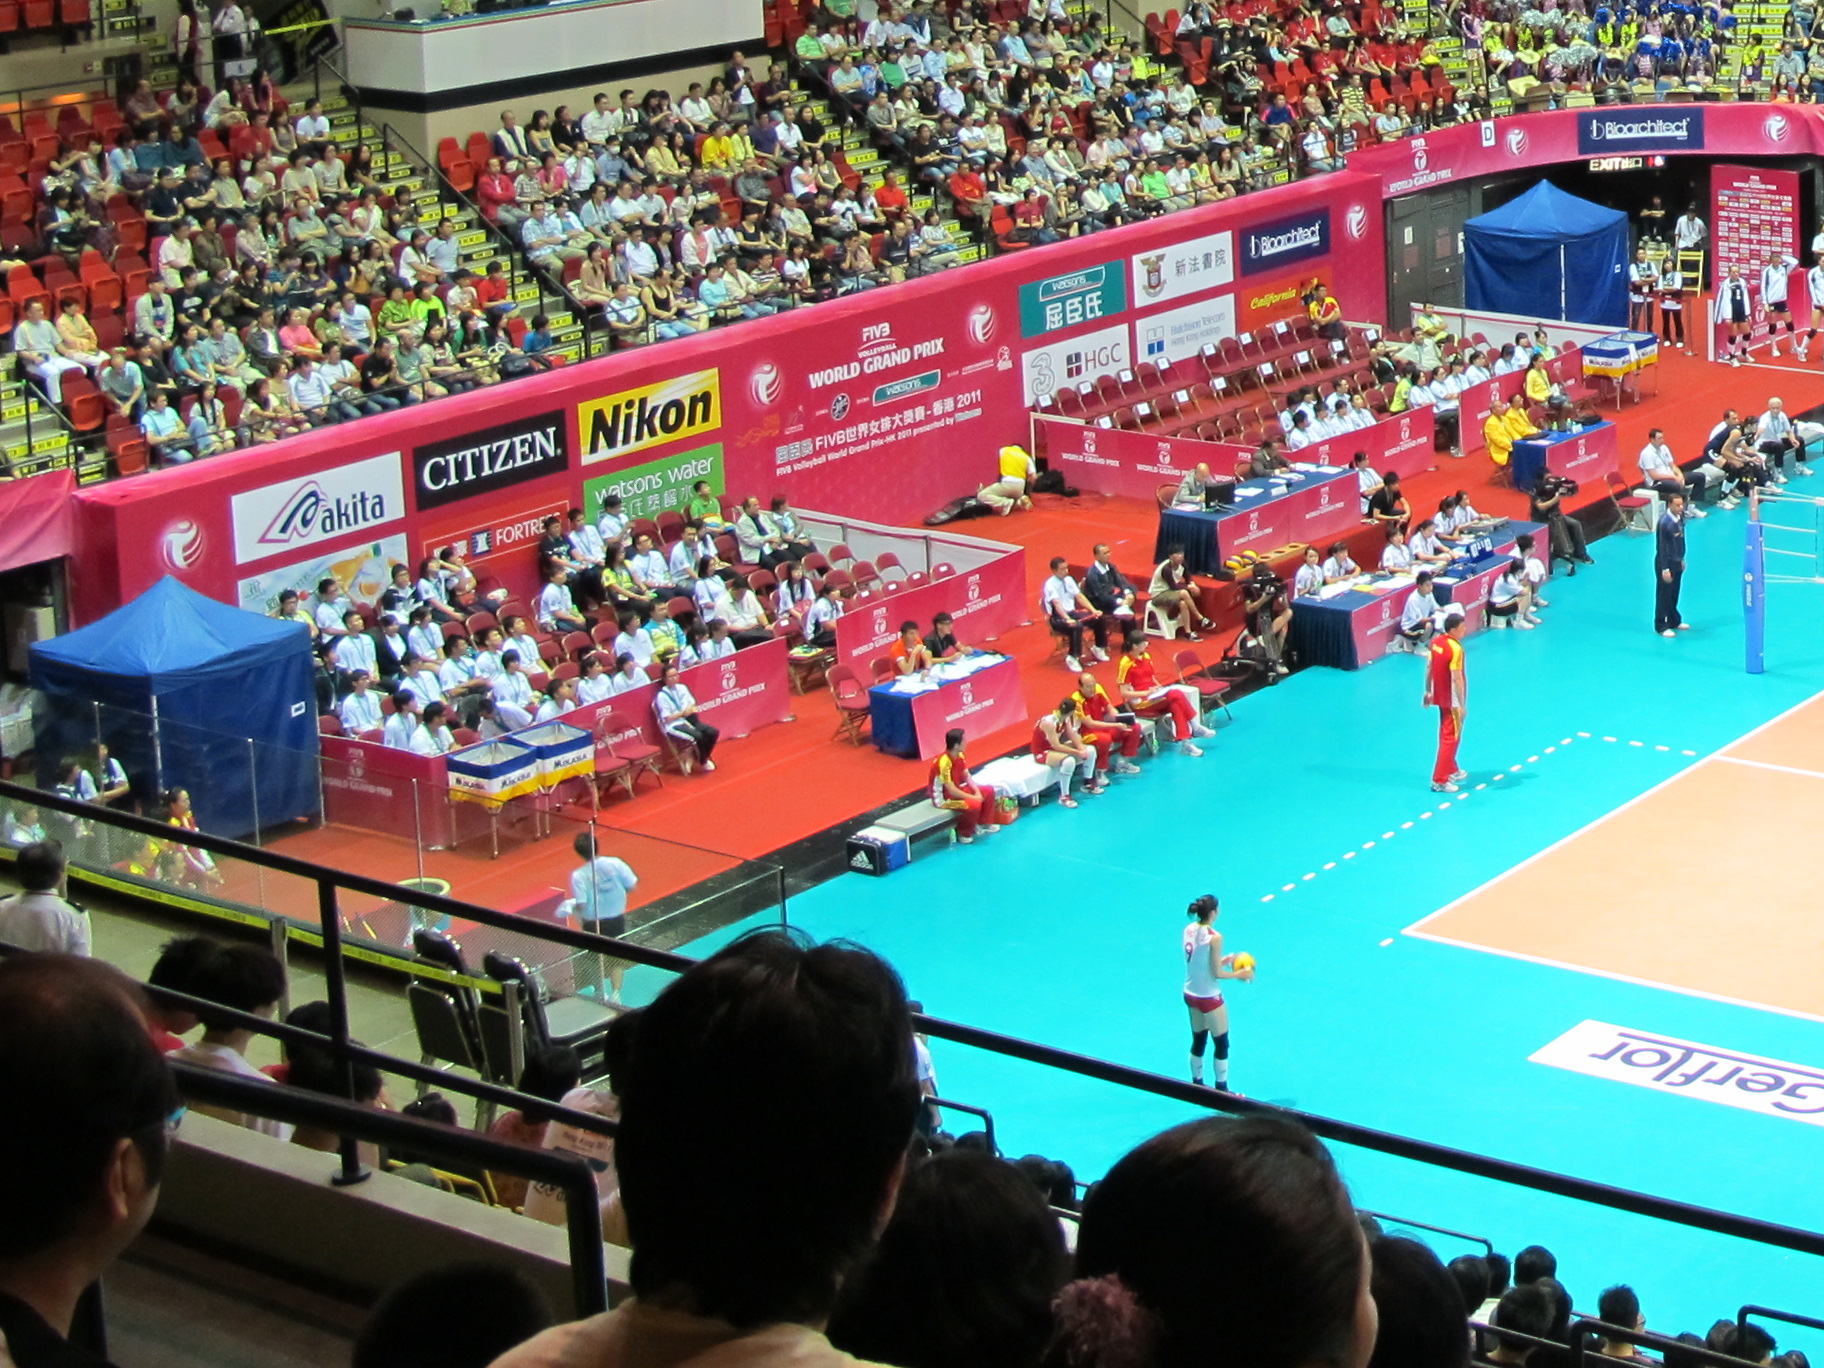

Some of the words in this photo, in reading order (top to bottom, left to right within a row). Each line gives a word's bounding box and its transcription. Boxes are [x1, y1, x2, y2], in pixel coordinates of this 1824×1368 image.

[1484, 125, 1493, 141] D
[1605, 118, 1689, 135] Bioarchitect
[1589, 158, 1621, 172] EXIT
[1261, 221, 1321, 252] Bioarchitect
[1045, 290, 1104, 331] 屈臣氏
[1249, 287, 1298, 311] California
[862, 321, 891, 342] FIVB
[857, 342, 898, 359] VOLLEYBALL
[1084, 341, 1123, 372] HGC
[808, 360, 861, 390] WORLD
[863, 348, 911, 375] GRAND
[913, 337, 945, 360] PRIX
[956, 388, 983, 409] 2011
[589, 390, 713, 455] Nikon
[422, 426, 558, 492] CITIZEN
[668, 457, 714, 484] water
[320, 491, 386, 534] akita
[495, 510, 562, 547] FORTRE
[722, 688, 750, 706] GRAND
[1184, 941, 1195, 964] 9
